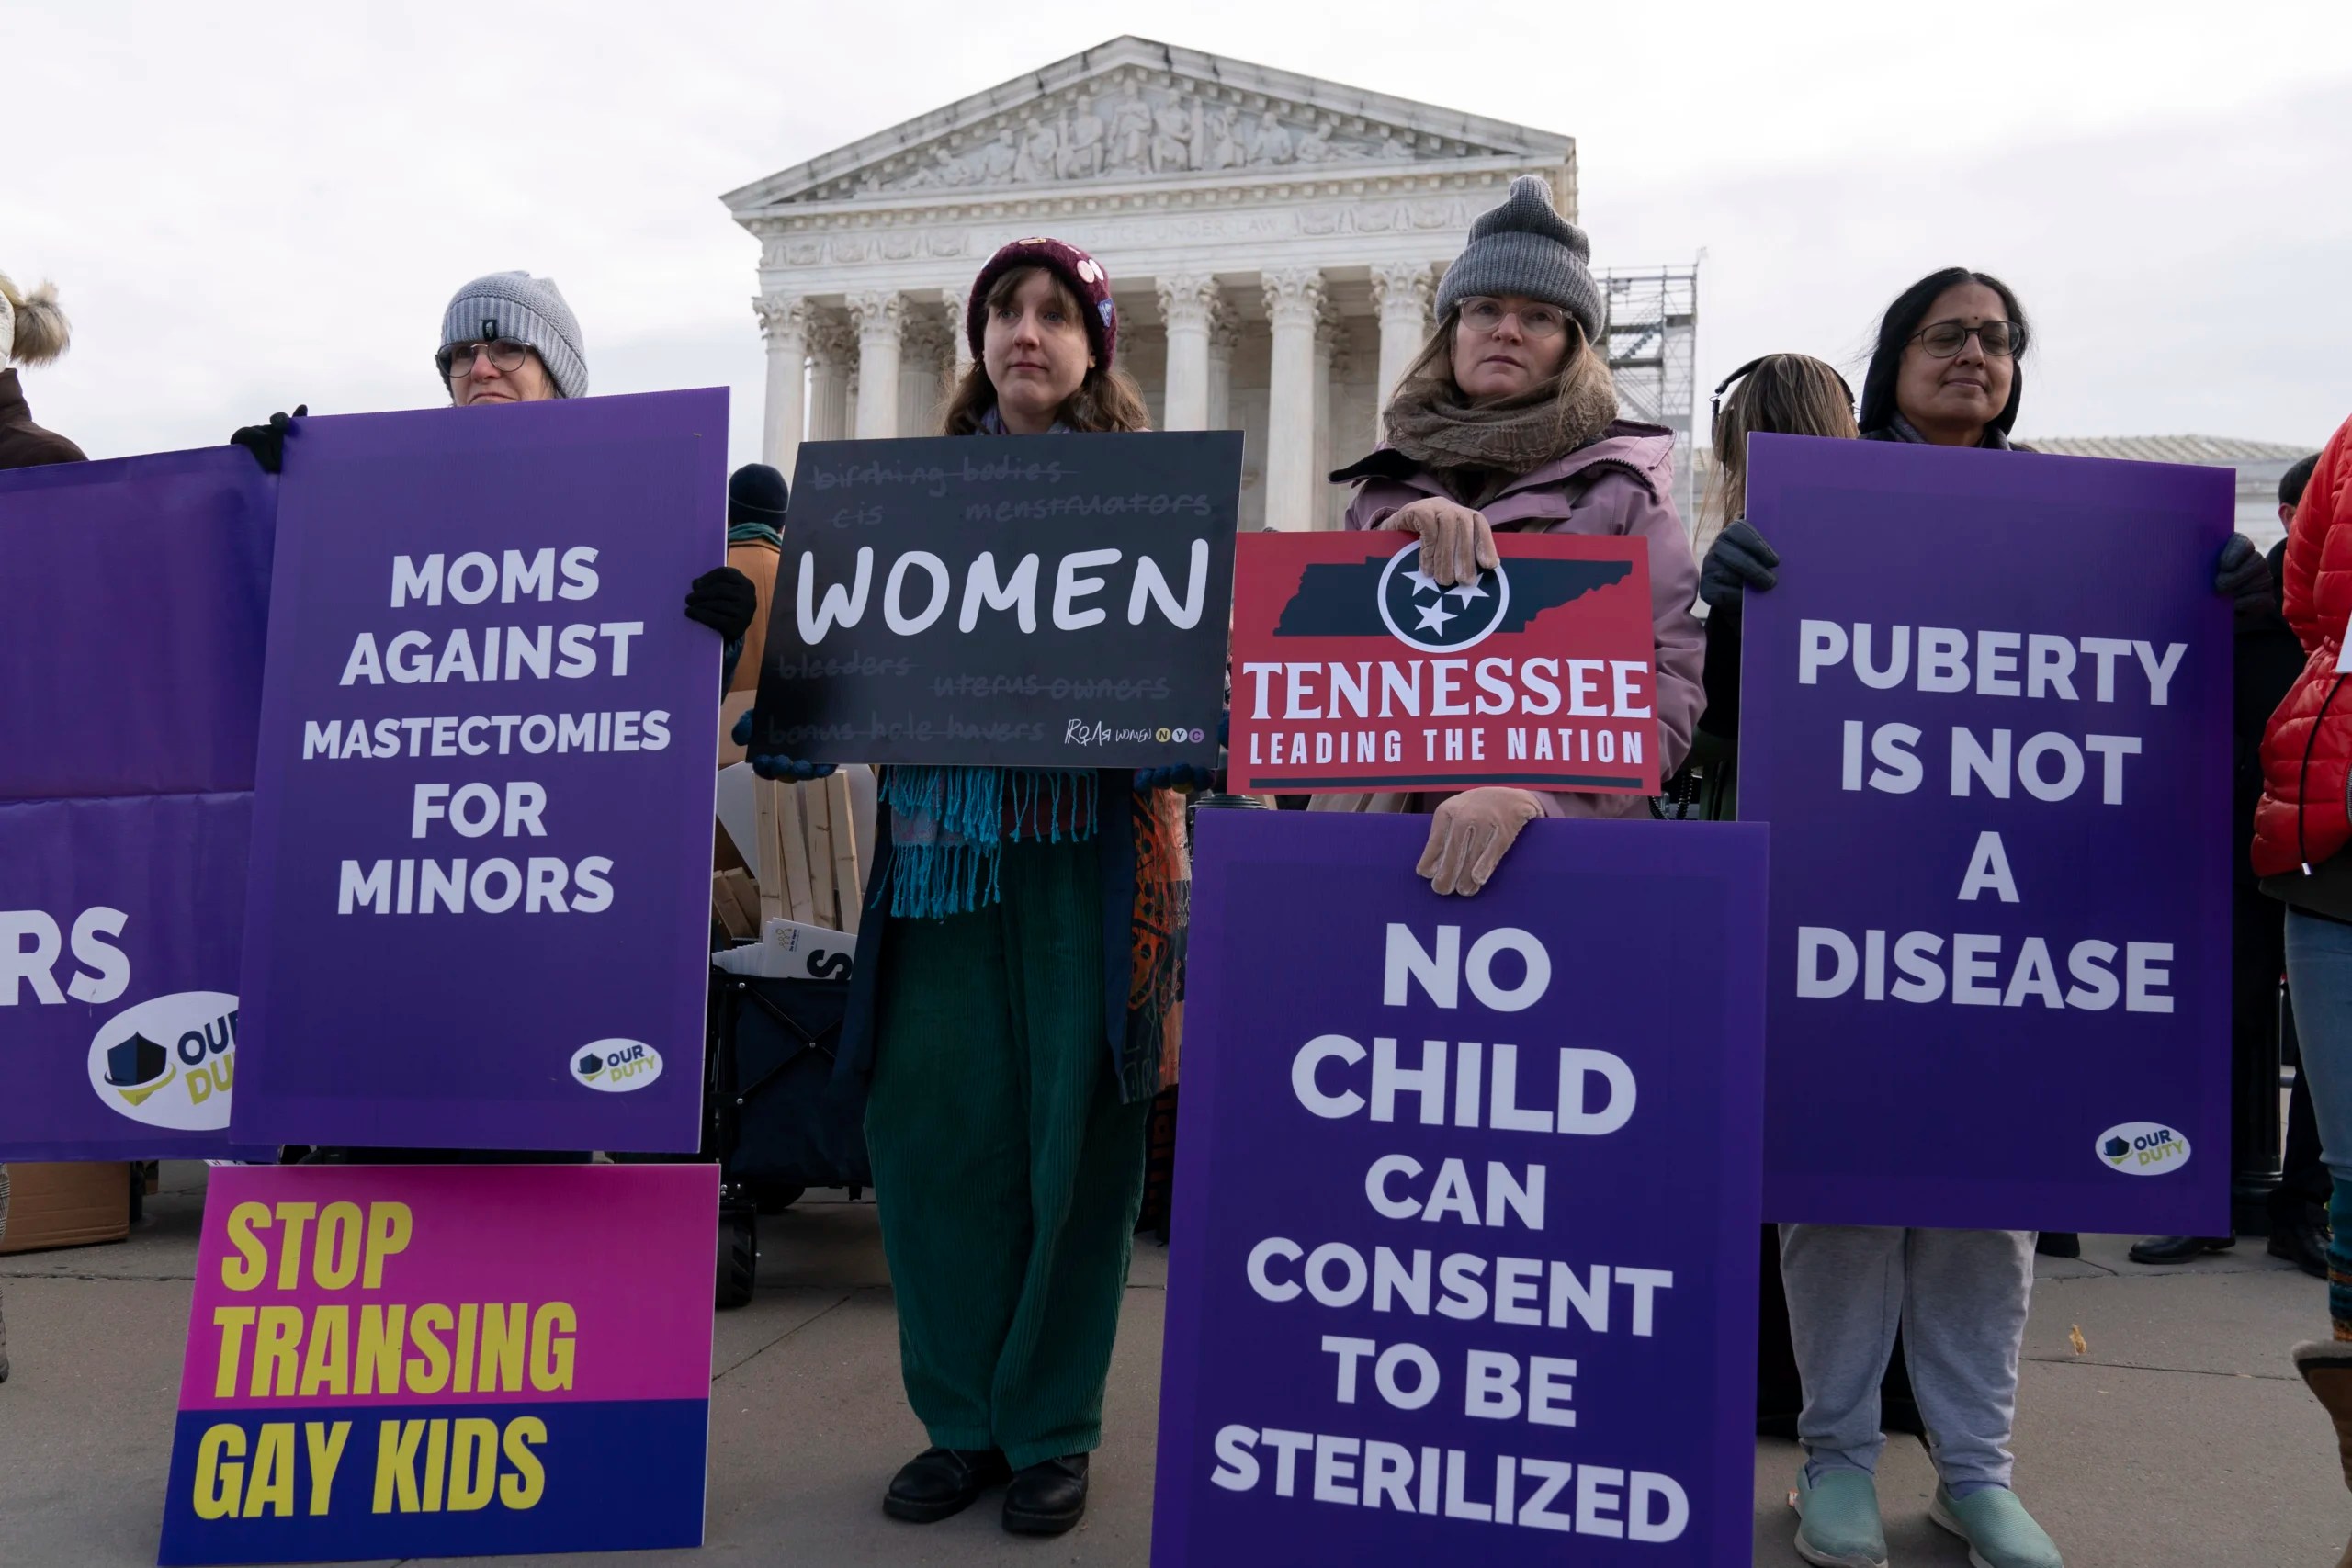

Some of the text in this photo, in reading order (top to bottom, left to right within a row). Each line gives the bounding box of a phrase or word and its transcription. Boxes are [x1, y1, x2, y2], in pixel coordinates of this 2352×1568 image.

[812, 455, 1061, 498] birthing bodies
[832, 491, 1212, 529] cis menstruators
[391, 547, 599, 607] MOMS
[797, 539, 1208, 645] WOMEN
[340, 622, 643, 685] AGAINST
[778, 652, 910, 680] bleeders
[1799, 620, 2187, 705] PUBERTY
[934, 673, 1171, 701] uterus owners
[1243, 657, 1651, 719] TENNESSEE
[303, 710, 670, 759] MASTECTOMIES
[871, 710, 933, 742] hole
[948, 713, 1044, 743] havers
[1115, 728, 1151, 742] WOMEN
[1250, 728, 1642, 764] LEADING THE NATION
[1843, 721, 2141, 804] IS NOT
[413, 782, 547, 838] FOR
[338, 856, 613, 914] MINORS
[1959, 831, 2018, 902] A
[1384, 923, 1551, 1011] NO
[1798, 927, 2173, 1012] DISEASE
[186, 1052, 235, 1105] DU
[607, 1045, 644, 1066] OUR
[610, 1055, 655, 1082] DUTY
[1292, 1035, 1636, 1134] CHILD
[2134, 1129, 2172, 1150] OUR
[2138, 1140, 2183, 1166] DUTY
[1366, 1155, 1545, 1229] CAN
[222, 1202, 412, 1291] STOP
[1248, 1238, 1672, 1337] CONSENT
[214, 1303, 576, 1397] TRANSING
[1322, 1336, 1576, 1427] TO BE
[194, 1416, 547, 1518] GAY KIDS
[1211, 1424, 1688, 1542] STERILIZED
